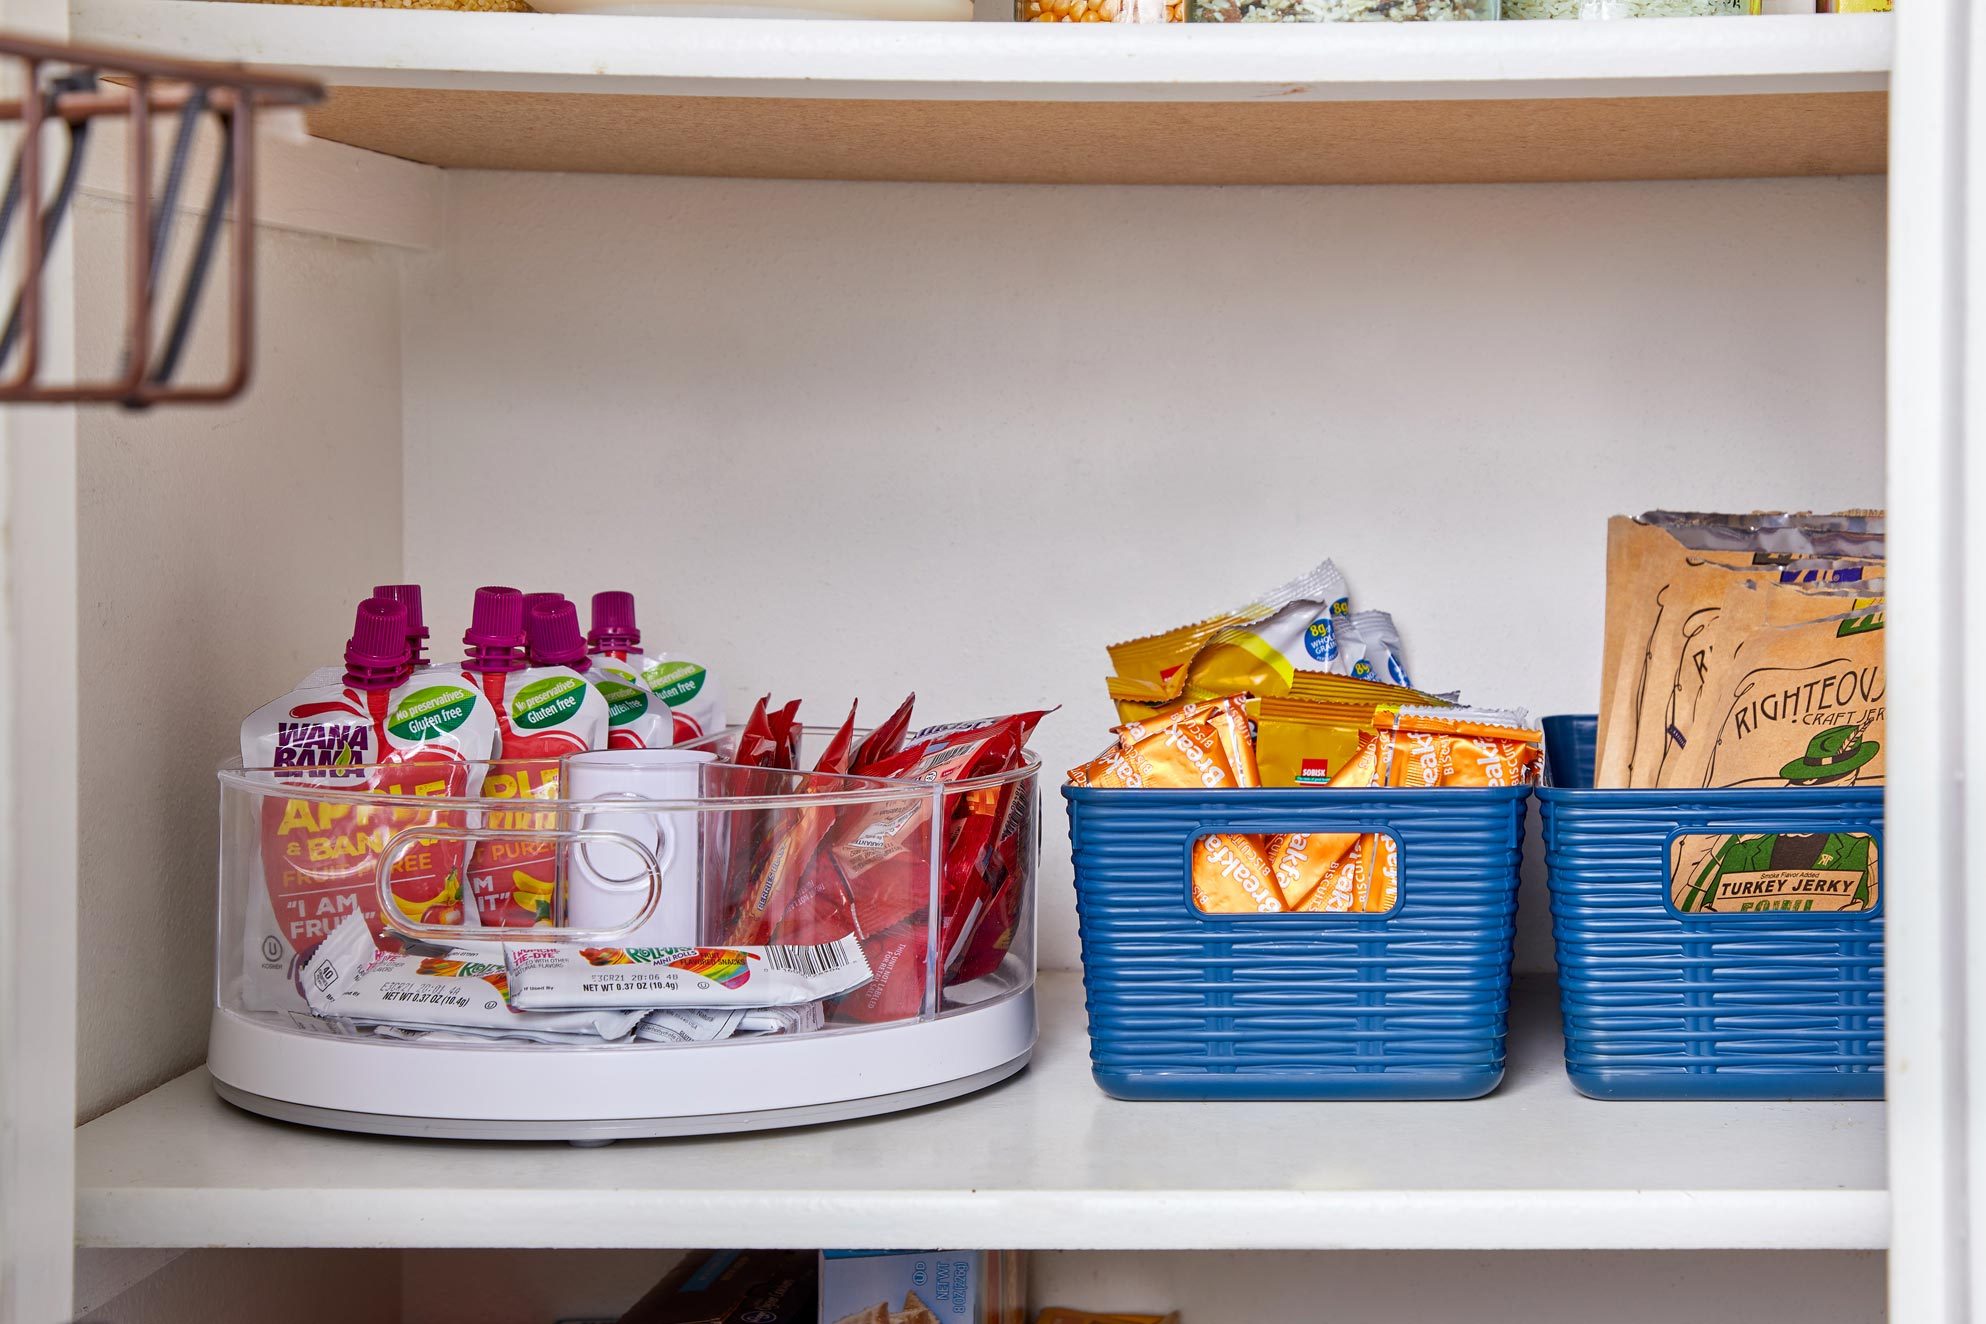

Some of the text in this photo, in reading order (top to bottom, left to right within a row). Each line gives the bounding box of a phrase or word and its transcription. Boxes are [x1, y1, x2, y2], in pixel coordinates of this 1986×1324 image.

[1310, 623, 1326, 637] 8g
[515, 678, 577, 712] No preservatives
[677, 680, 696, 693] free
[408, 689, 465, 715] preservatives
[527, 695, 577, 724] Gluten free
[408, 706, 463, 734] Gluten free
[1802, 707, 1885, 726] CRAFT JER
[277, 722, 369, 750] WANA
[1186, 720, 1214, 748] BISCU
[273, 747, 366, 778] BANA
[1165, 722, 1225, 788] Break
[287, 842, 301, 856] &
[283, 852, 433, 889] FRUIT PREE
[1204, 834, 1282, 912] Breakfa
[757, 872, 775, 911] BERRIES
[1721, 878, 1856, 896] TURKEY JERKY
[316, 893, 358, 916] AM
[653, 950, 698, 967] MINI ROLLS
[883, 951, 893, 964] FOR
[322, 966, 334, 980] 40
[631, 973, 660, 982] 20:06
[880, 970, 892, 983] NOT
[583, 981, 679, 992] NET WT 0.37 OZ (10.4g)
[382, 991, 471, 1008] NET WT 0.37 OZ (10.4g)
[936, 1262, 949, 1300] NET WT
[952, 1291, 966, 1305] OZ
